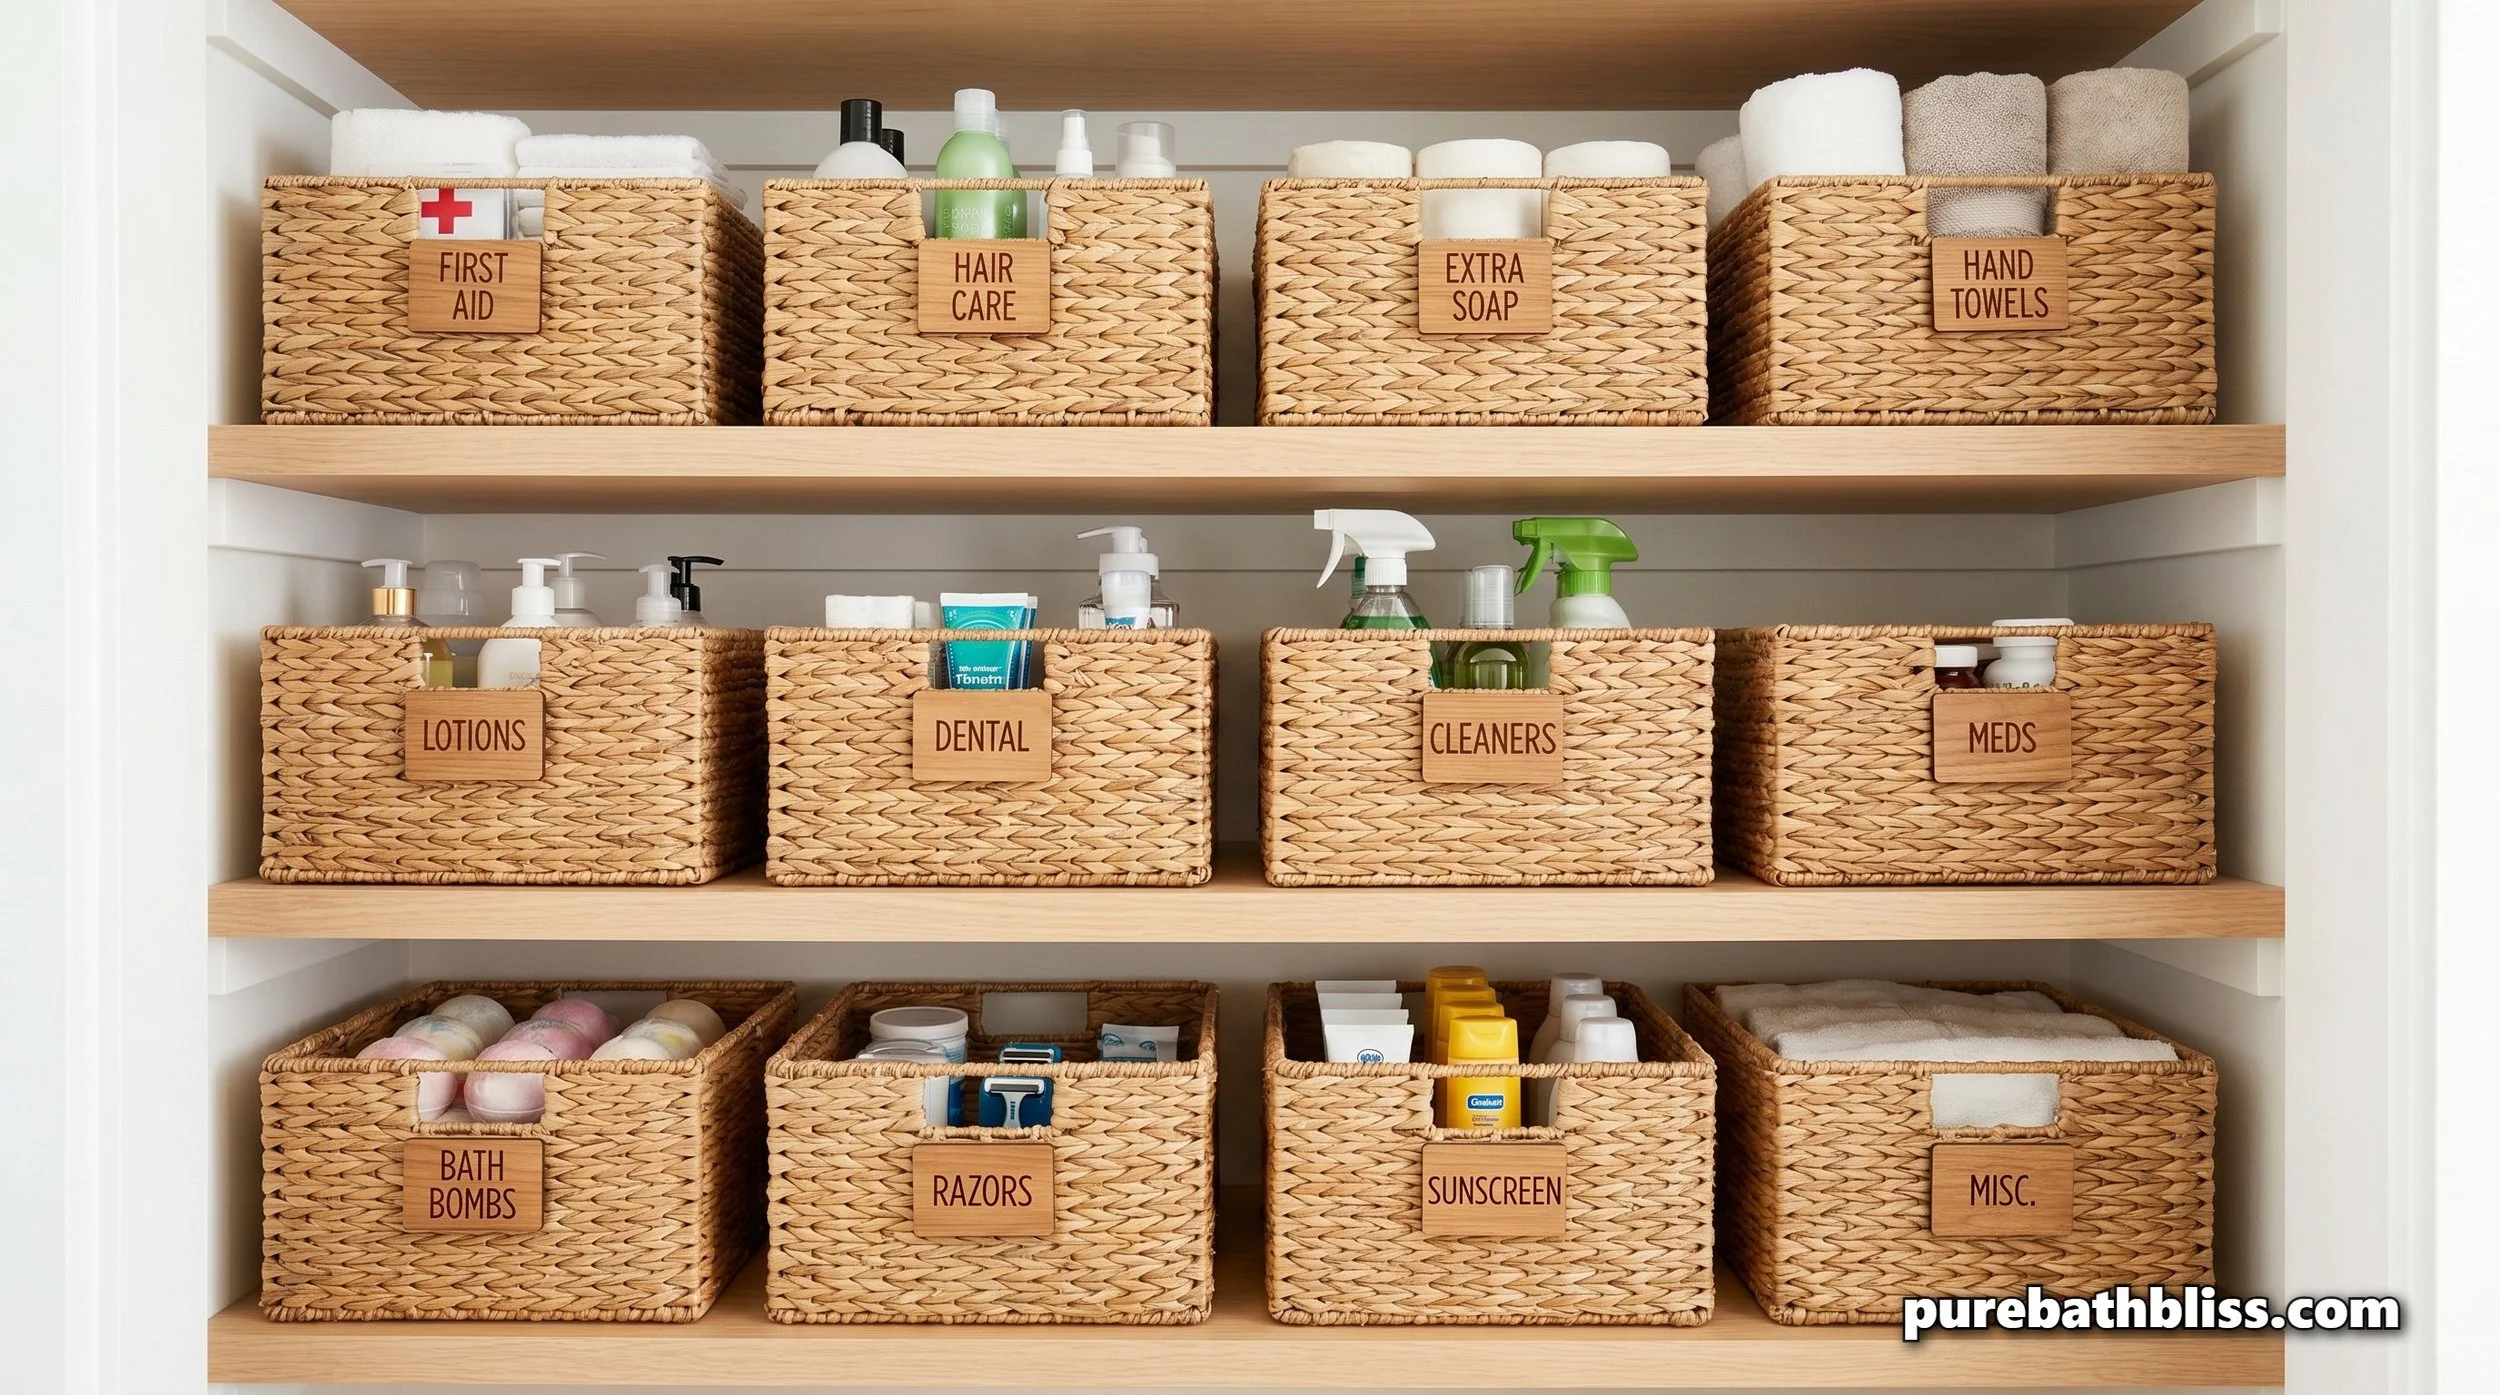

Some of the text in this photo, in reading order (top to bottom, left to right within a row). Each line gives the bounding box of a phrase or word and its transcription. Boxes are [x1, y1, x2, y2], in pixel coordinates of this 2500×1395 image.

[440, 251, 509, 284] FIRST
[955, 252, 1013, 283] HAIR
[1446, 252, 1525, 284] EXTRA
[1964, 249, 2034, 281] HAND
[452, 289, 494, 321] AID
[952, 289, 1017, 321] CARE
[1452, 290, 1519, 322] SOAP
[1950, 286, 2049, 319] TOWELS
[423, 719, 526, 752] LOTIONS
[936, 719, 1030, 752] DENTAL
[1430, 722, 1556, 755] CLEANERS
[1969, 721, 2037, 754] MEDS
[441, 1149, 504, 1182] BATH
[429, 1186, 517, 1220] BOMBS
[933, 1174, 1033, 1207] RAZORS
[1428, 1175, 1562, 1206] SUNSCREEN
[1970, 1174, 2036, 1207] MISC.
